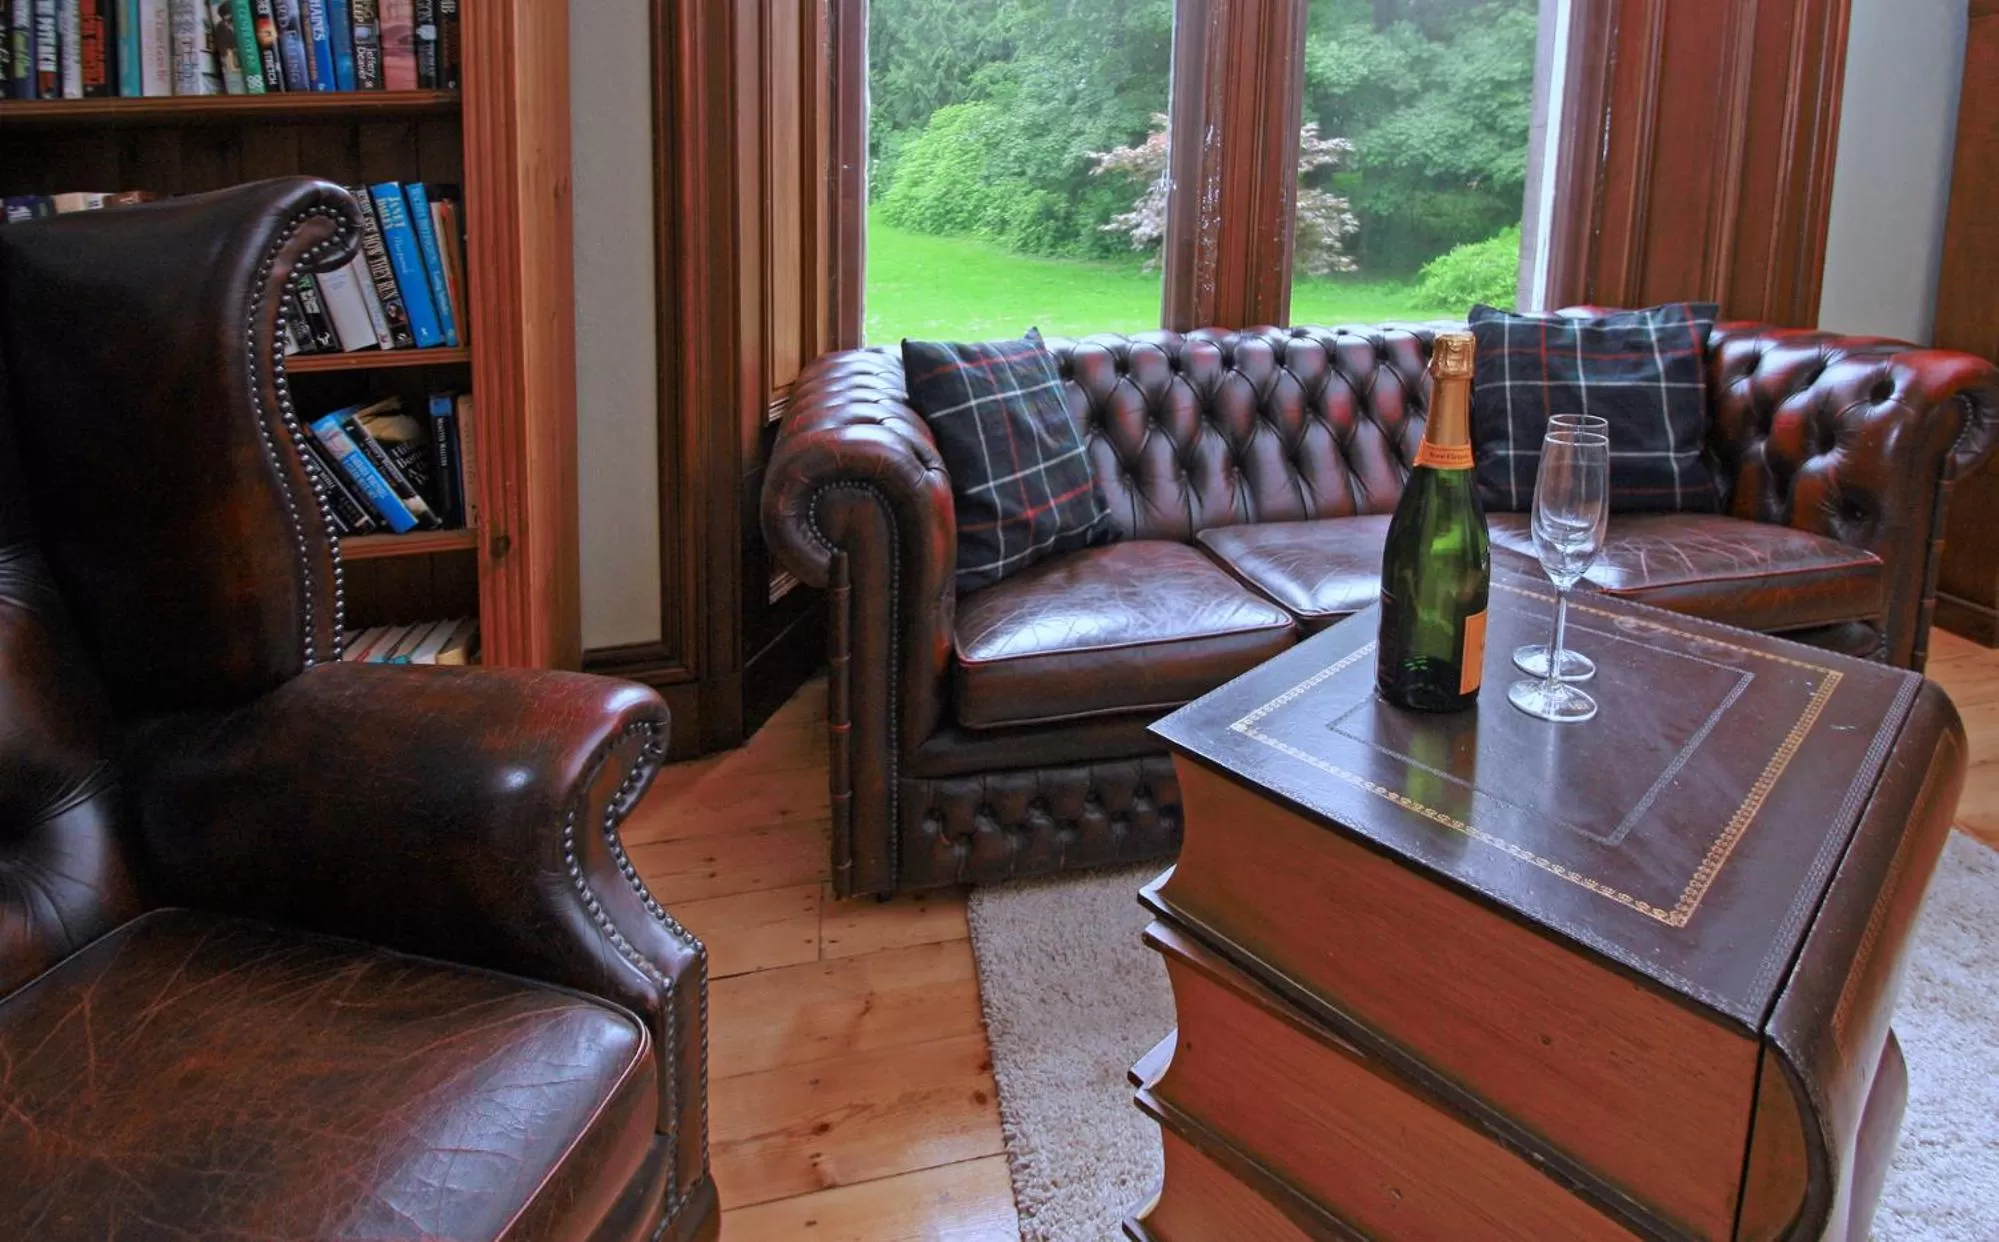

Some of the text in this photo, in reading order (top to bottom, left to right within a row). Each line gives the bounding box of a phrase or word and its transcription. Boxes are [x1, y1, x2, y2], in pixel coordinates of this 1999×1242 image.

[356, 46, 367, 80] Deaver
[364, 235, 383, 256] HOW
[369, 256, 389, 279] THEY
[377, 278, 398, 301] RUN
